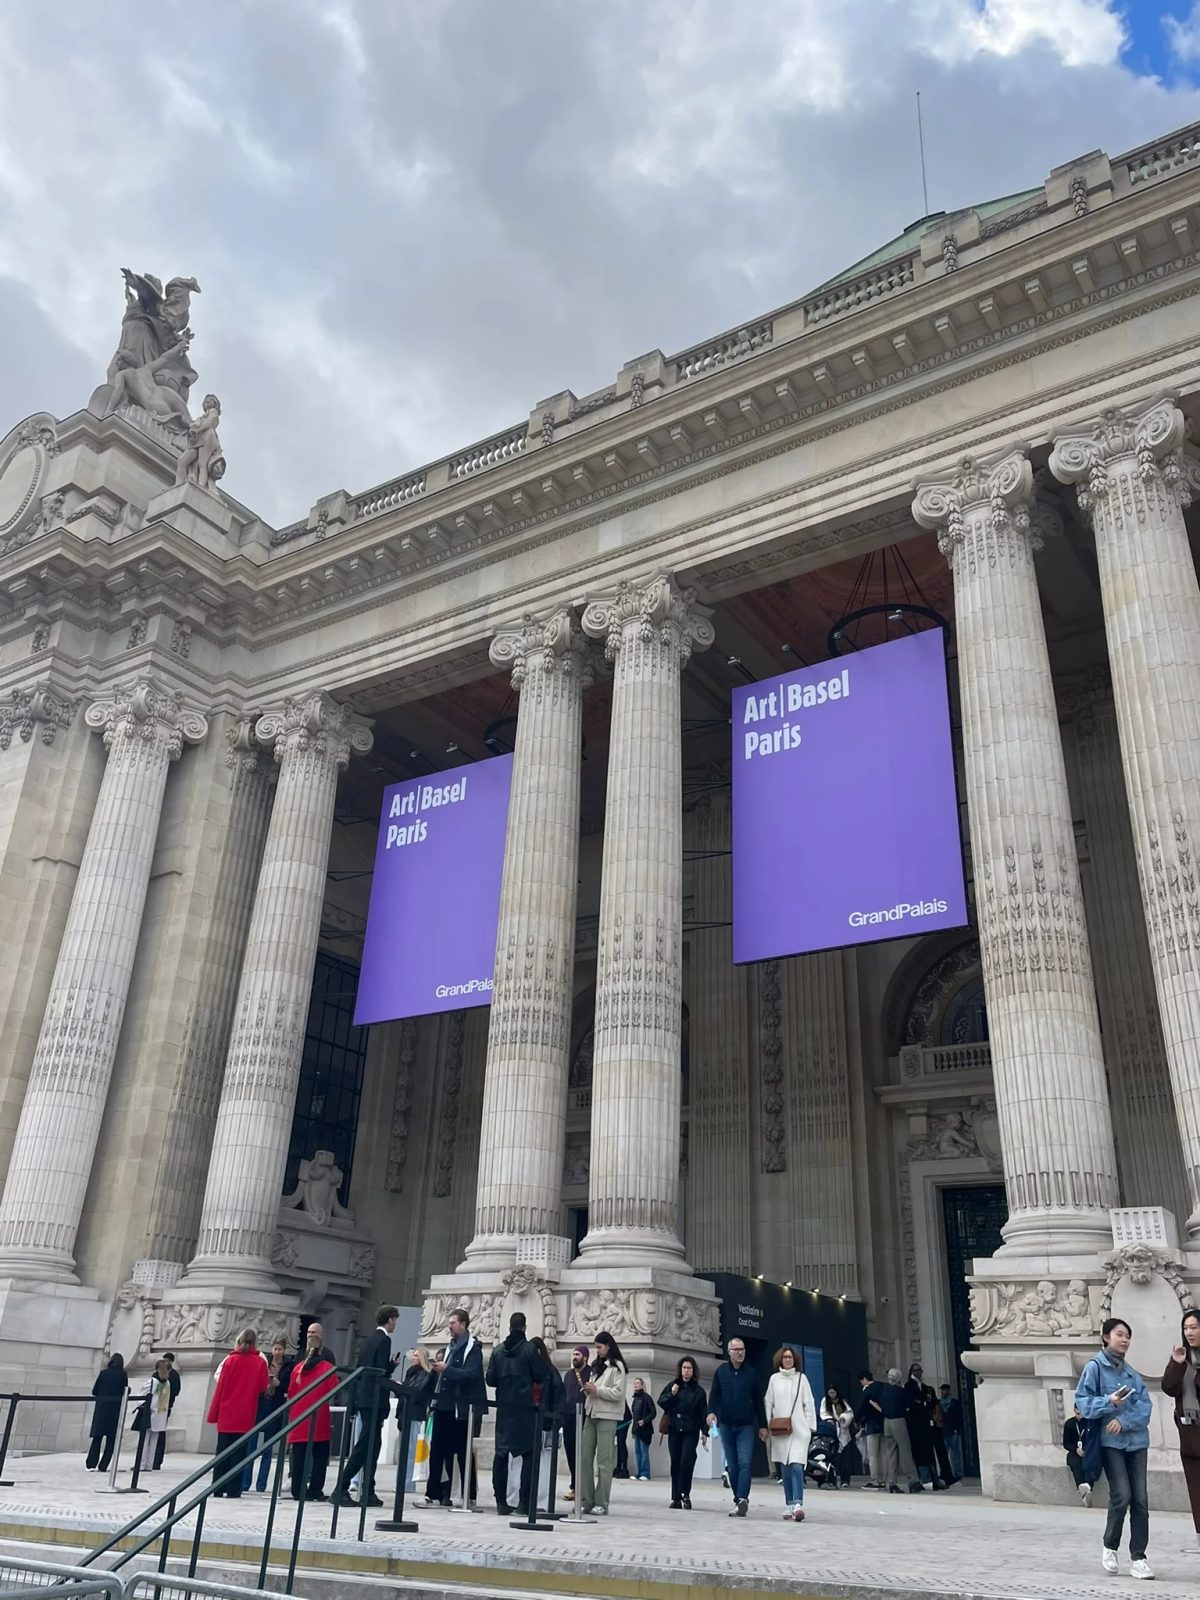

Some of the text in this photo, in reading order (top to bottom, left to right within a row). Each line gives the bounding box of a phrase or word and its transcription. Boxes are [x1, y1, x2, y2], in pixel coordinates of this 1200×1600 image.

[745, 722, 801, 760] Paris
[386, 819, 428, 849] Paris
[848, 898, 948, 927] GrandPalais
[436, 978, 493, 998] GrandPala
